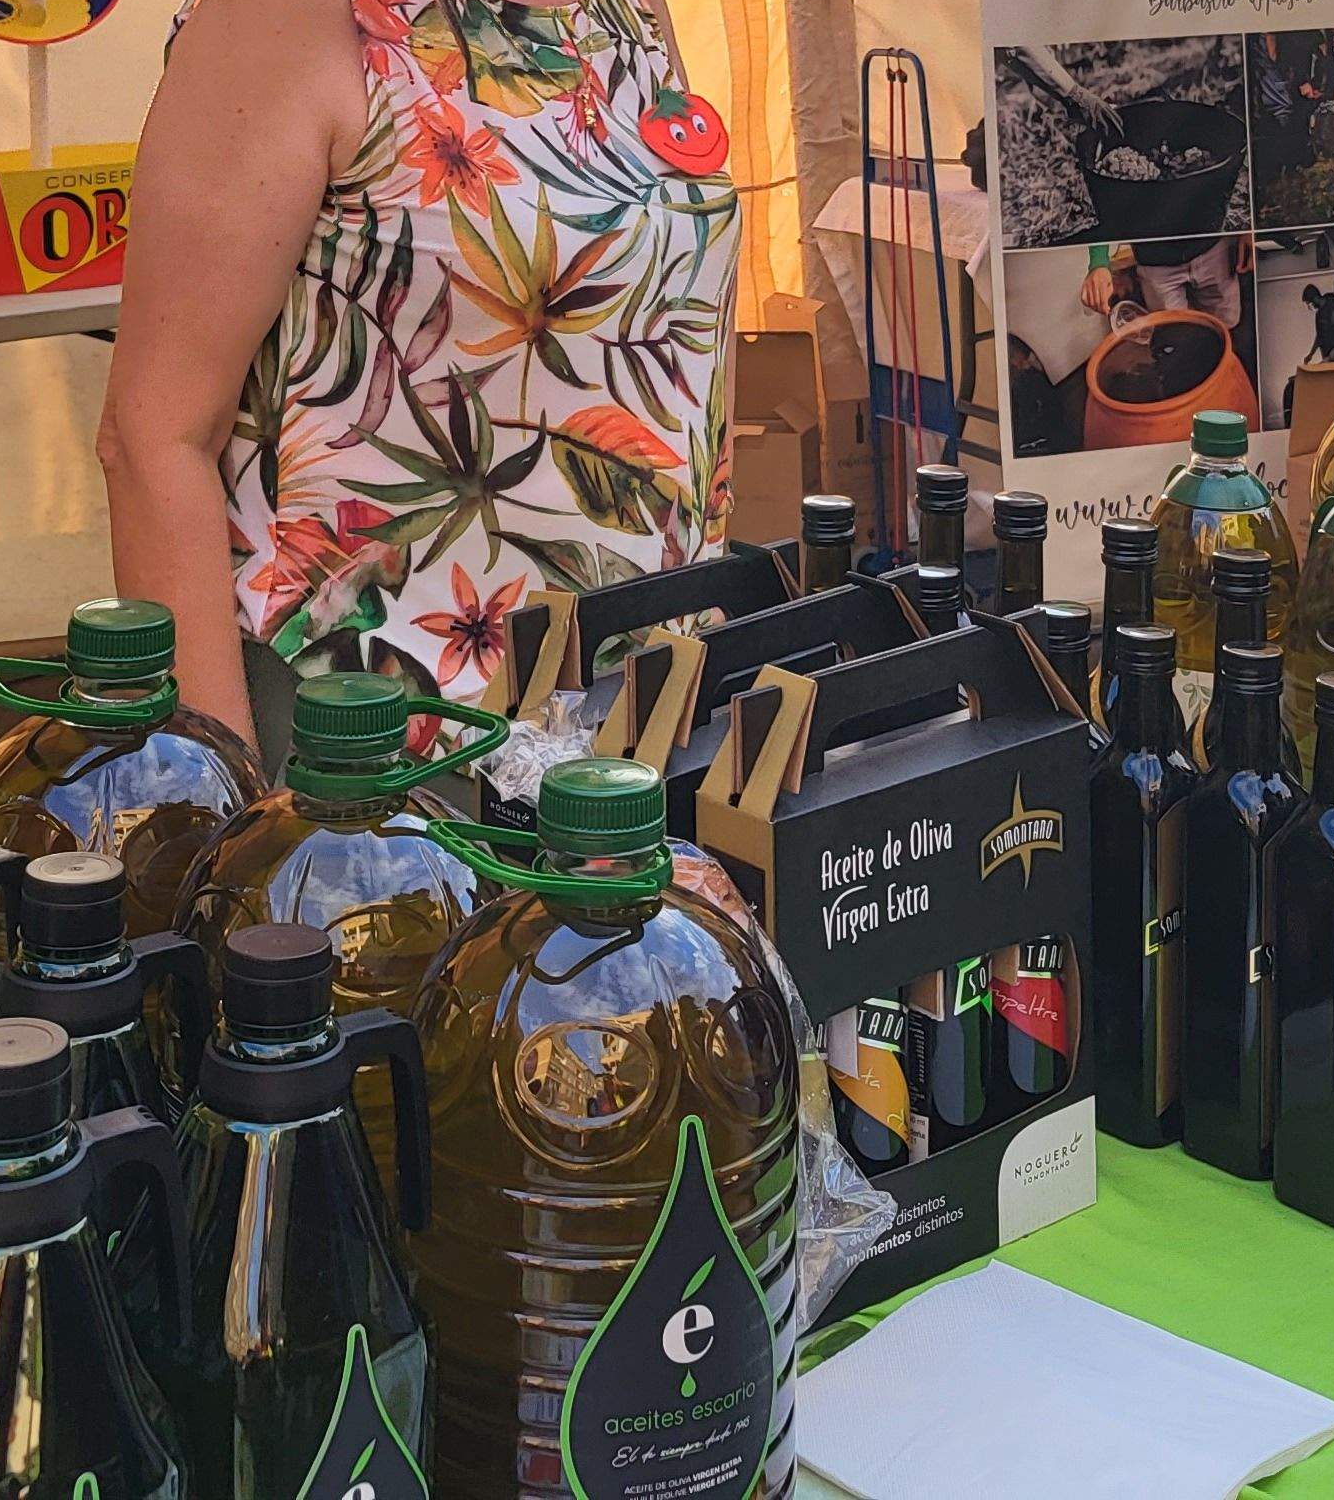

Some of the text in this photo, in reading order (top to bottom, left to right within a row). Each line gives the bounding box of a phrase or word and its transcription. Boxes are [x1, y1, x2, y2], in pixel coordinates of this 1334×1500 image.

[45, 169, 131, 189] CONSER
[20, 188, 131, 274] OR
[821, 818, 952, 891] Aceite de Oliva
[990, 819, 1054, 859] SOMONTANO
[822, 883, 929, 951] Virgen Extra
[1022, 1159, 1071, 1185] SOMONTANO
[896, 1194, 947, 1226] distintos
[914, 1206, 964, 1238] distintos
[604, 1381, 756, 1435] aceites escario
[612, 1445, 640, 1468] El
[624, 1455, 743, 1495] ACEITE DE OLIVA VIRGEN EXTRA
[688, 1478, 716, 1494] VIERGE
[717, 1468, 739, 1485] EXTRA
